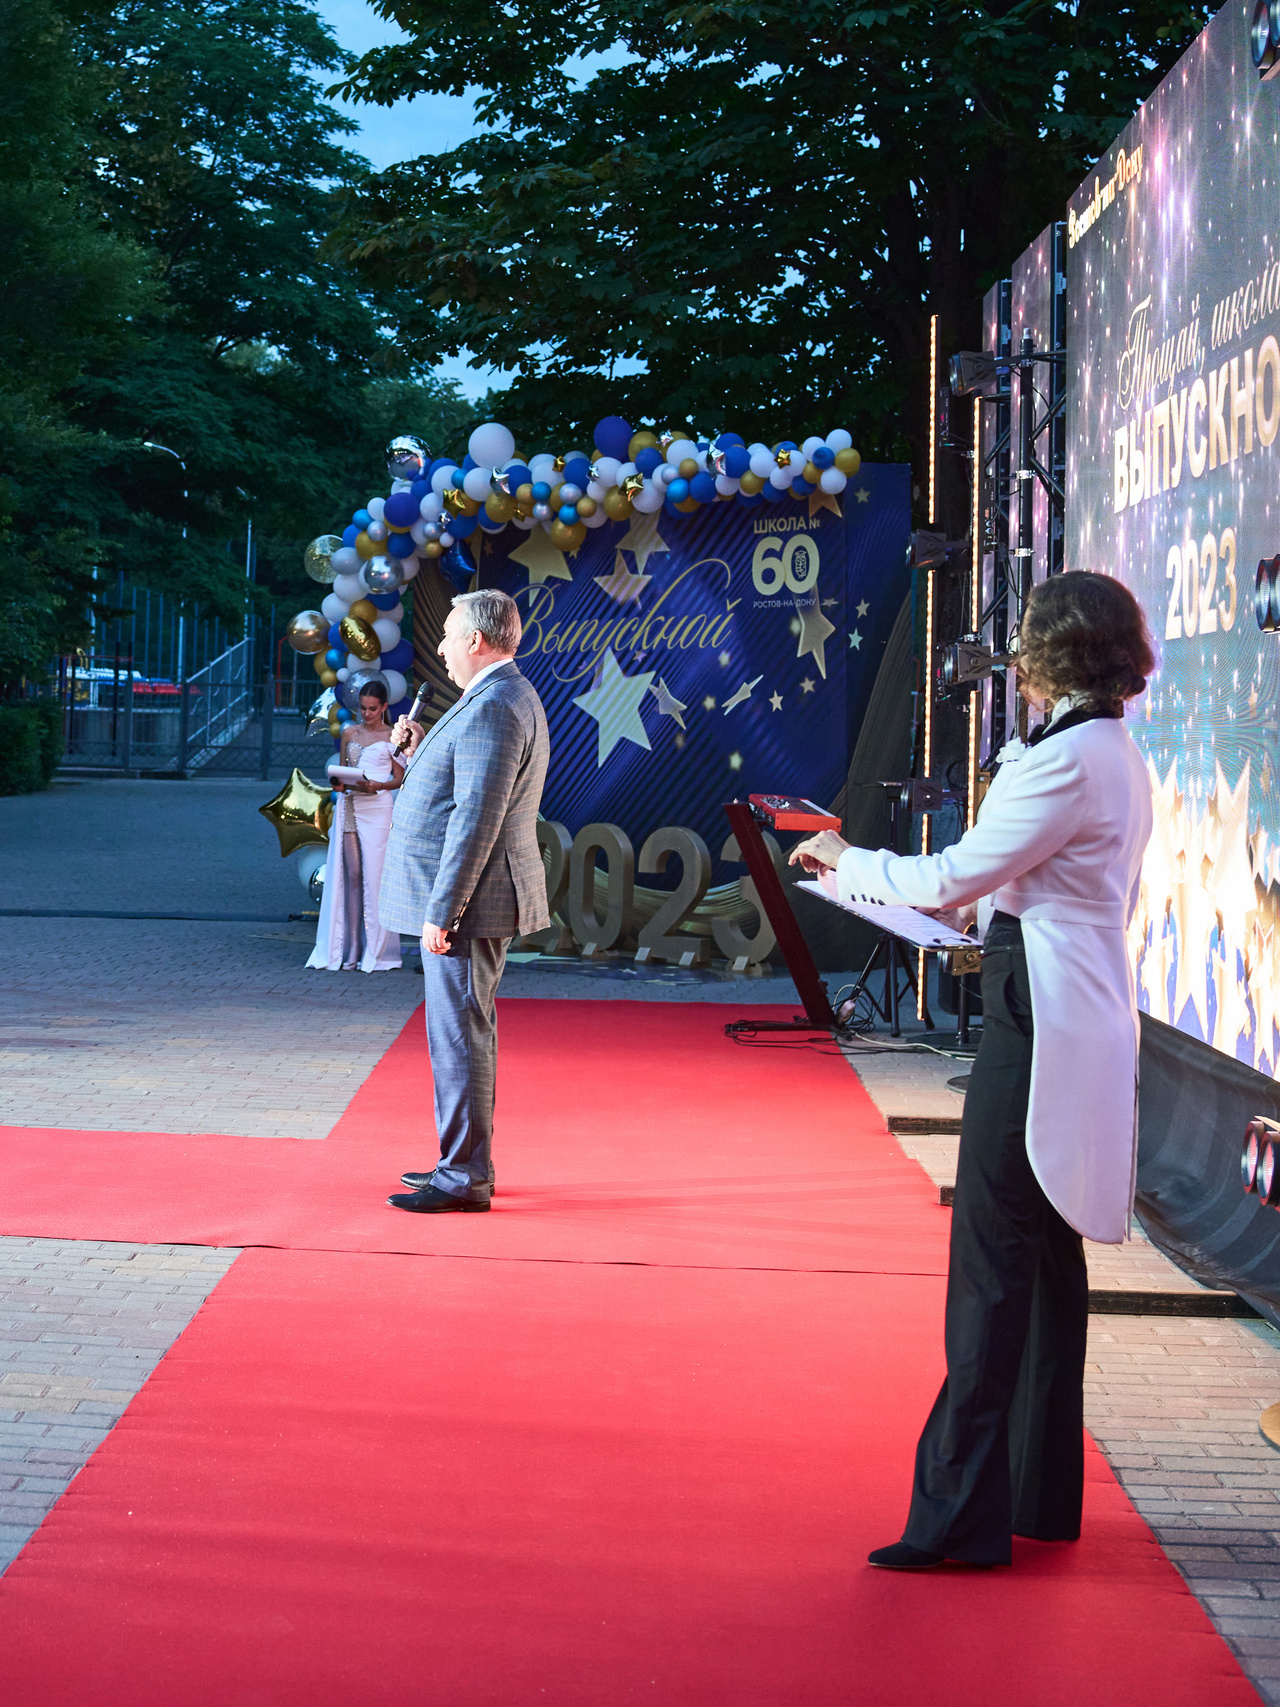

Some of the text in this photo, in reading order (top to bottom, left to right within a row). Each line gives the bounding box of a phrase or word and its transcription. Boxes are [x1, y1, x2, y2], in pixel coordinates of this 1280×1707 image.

[753, 516, 821, 534] ШКОЛА №
[751, 533, 820, 596] 60
[1165, 527, 1238, 640] 2023
[513, 558, 742, 682] Выпускной
[753, 598, 817, 609] РОСТОВ-НА-ДОНУ
